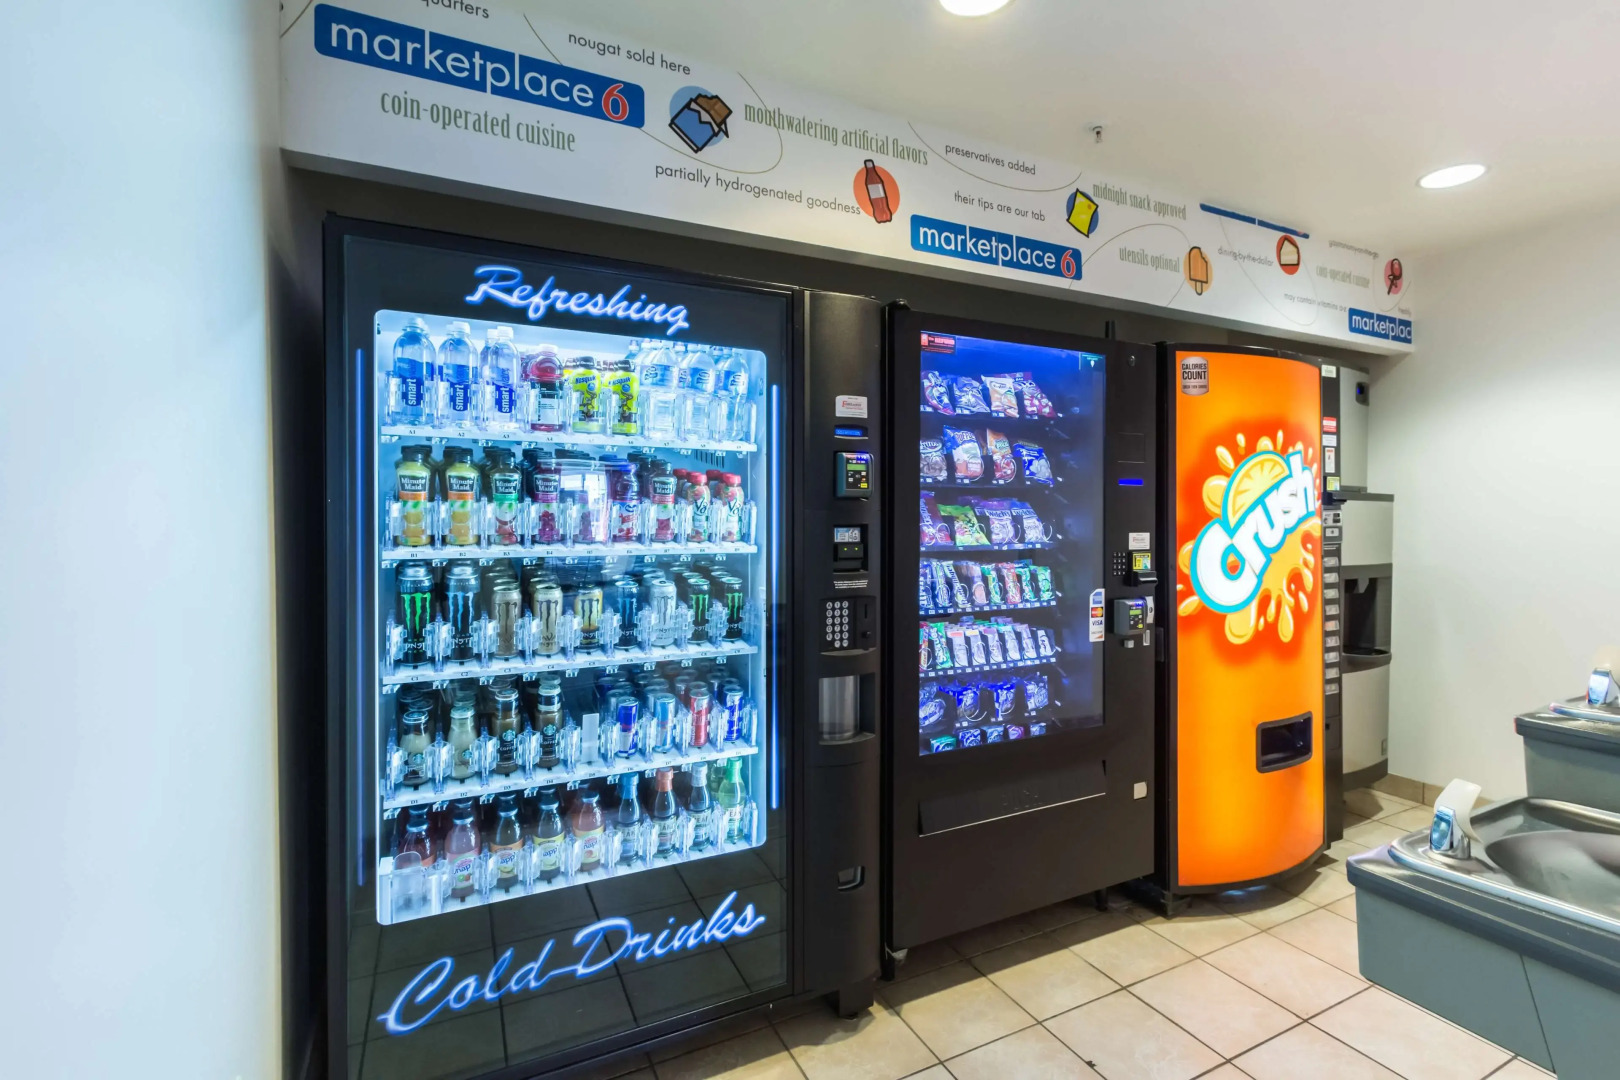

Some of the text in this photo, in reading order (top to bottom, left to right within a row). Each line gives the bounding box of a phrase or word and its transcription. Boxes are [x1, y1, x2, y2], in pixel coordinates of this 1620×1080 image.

[331, 22, 629, 122] marketplace 6
[568, 33, 690, 76] nougat sold here
[380, 91, 576, 152] coin-operated cuisine
[744, 102, 928, 166] mouthwatering artificial flavors
[945, 144, 1036, 175] preservatives added
[655, 164, 861, 216] partially hydrogenated goodness
[954, 192, 1046, 222] their tips are our tab
[1092, 183, 1186, 220] midnight snack approved
[920, 225, 1076, 278] marketplace 6
[1151, 256, 1180, 273] optional
[466, 264, 690, 336] Refreshing
[408, 378, 416, 406] smart
[455, 384, 464, 411] smart
[1182, 371, 1207, 380] COUNT
[1192, 451, 1315, 611] Crush
[376, 890, 767, 1036] Cold Drinks
